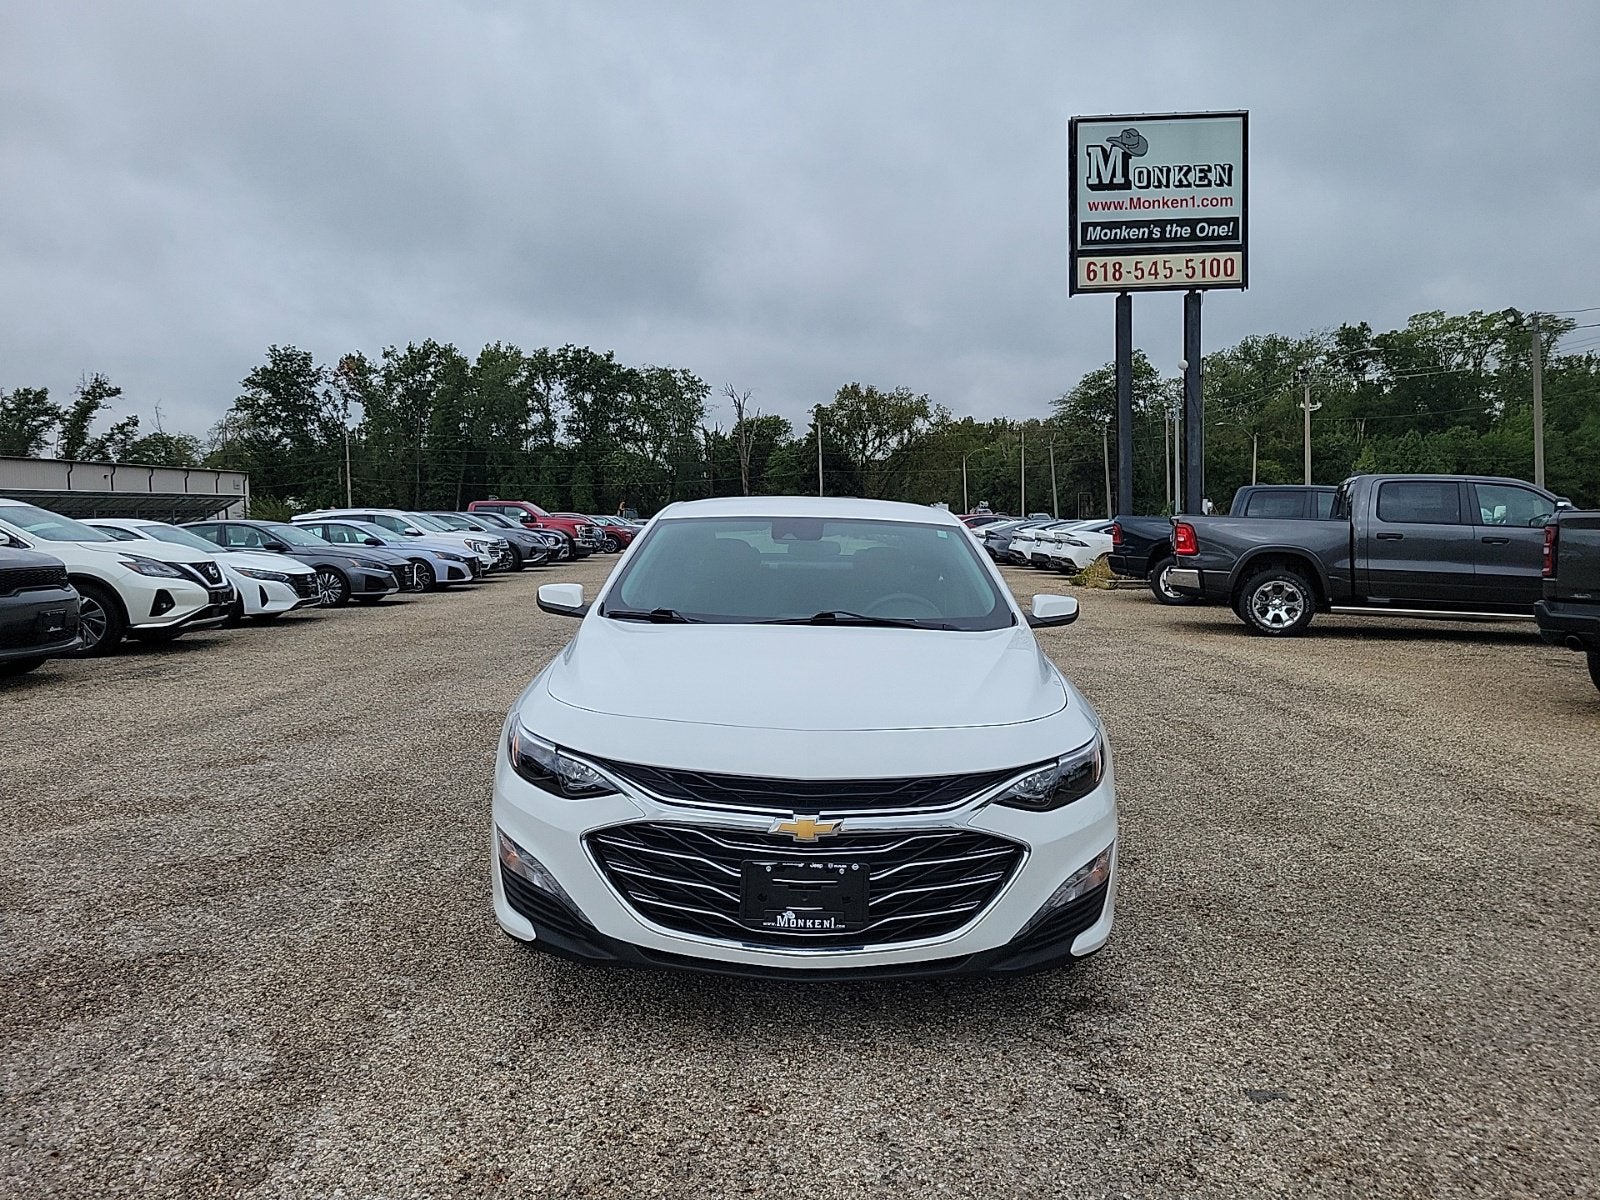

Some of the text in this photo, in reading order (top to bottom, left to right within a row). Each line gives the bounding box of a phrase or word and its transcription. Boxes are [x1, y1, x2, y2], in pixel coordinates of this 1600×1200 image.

[1087, 195, 1233, 212] www.Monken1.com
[1086, 221, 1234, 241] Monken's the One!
[1086, 256, 1235, 282] 618-545-5100
